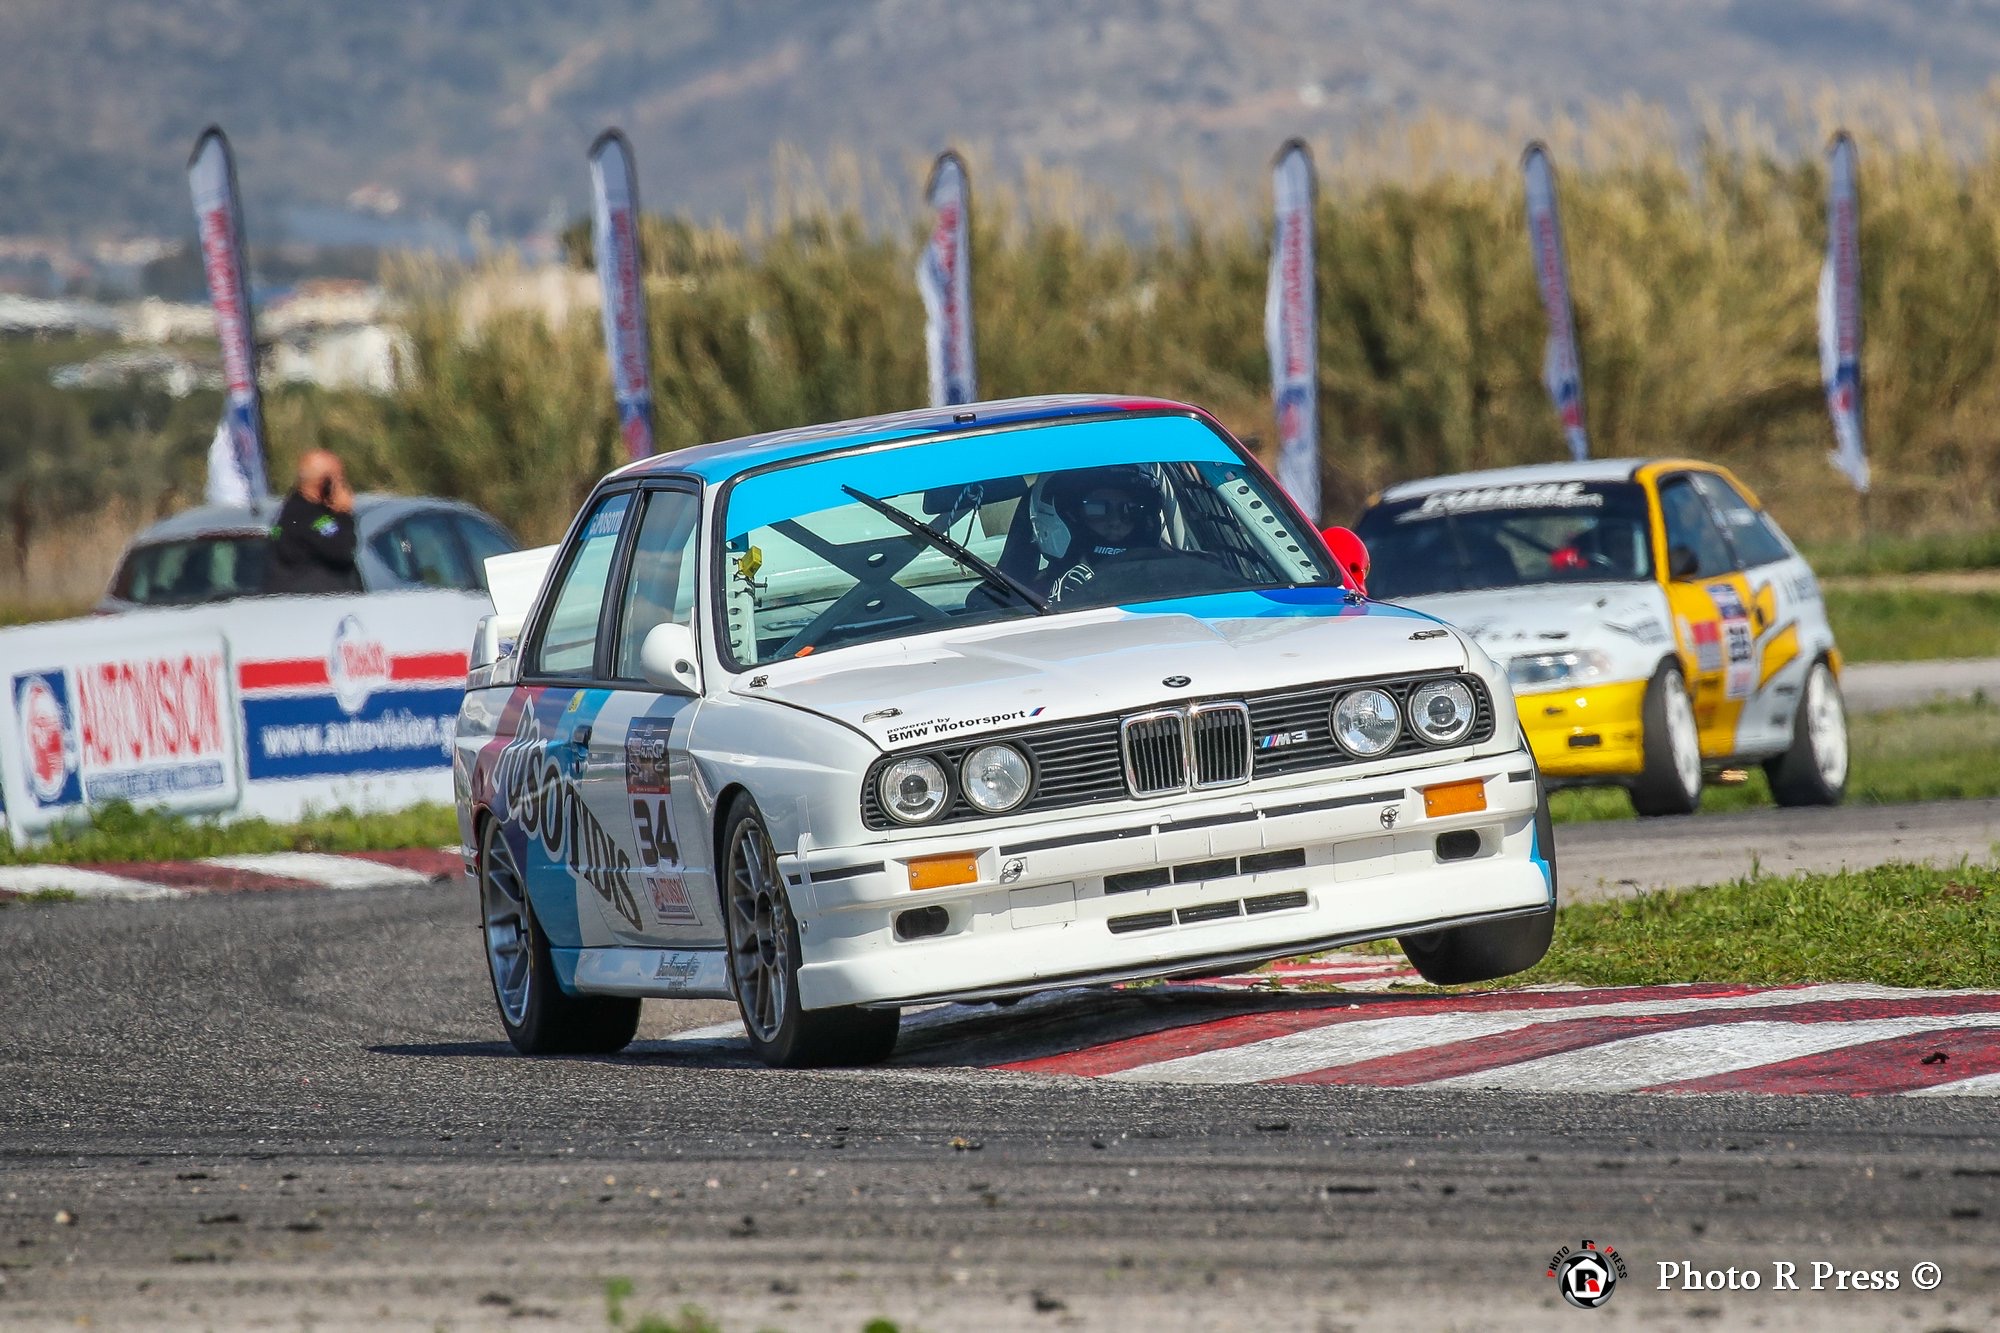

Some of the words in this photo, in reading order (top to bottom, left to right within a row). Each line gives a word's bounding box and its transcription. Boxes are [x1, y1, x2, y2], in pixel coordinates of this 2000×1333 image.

[886, 720, 934, 734] powered
[937, 717, 951, 725] by
[888, 727, 928, 743] BMW
[934, 710, 1026, 734] Motorsport
[1274, 730, 1308, 746] M3
[634, 799, 680, 868] 34
